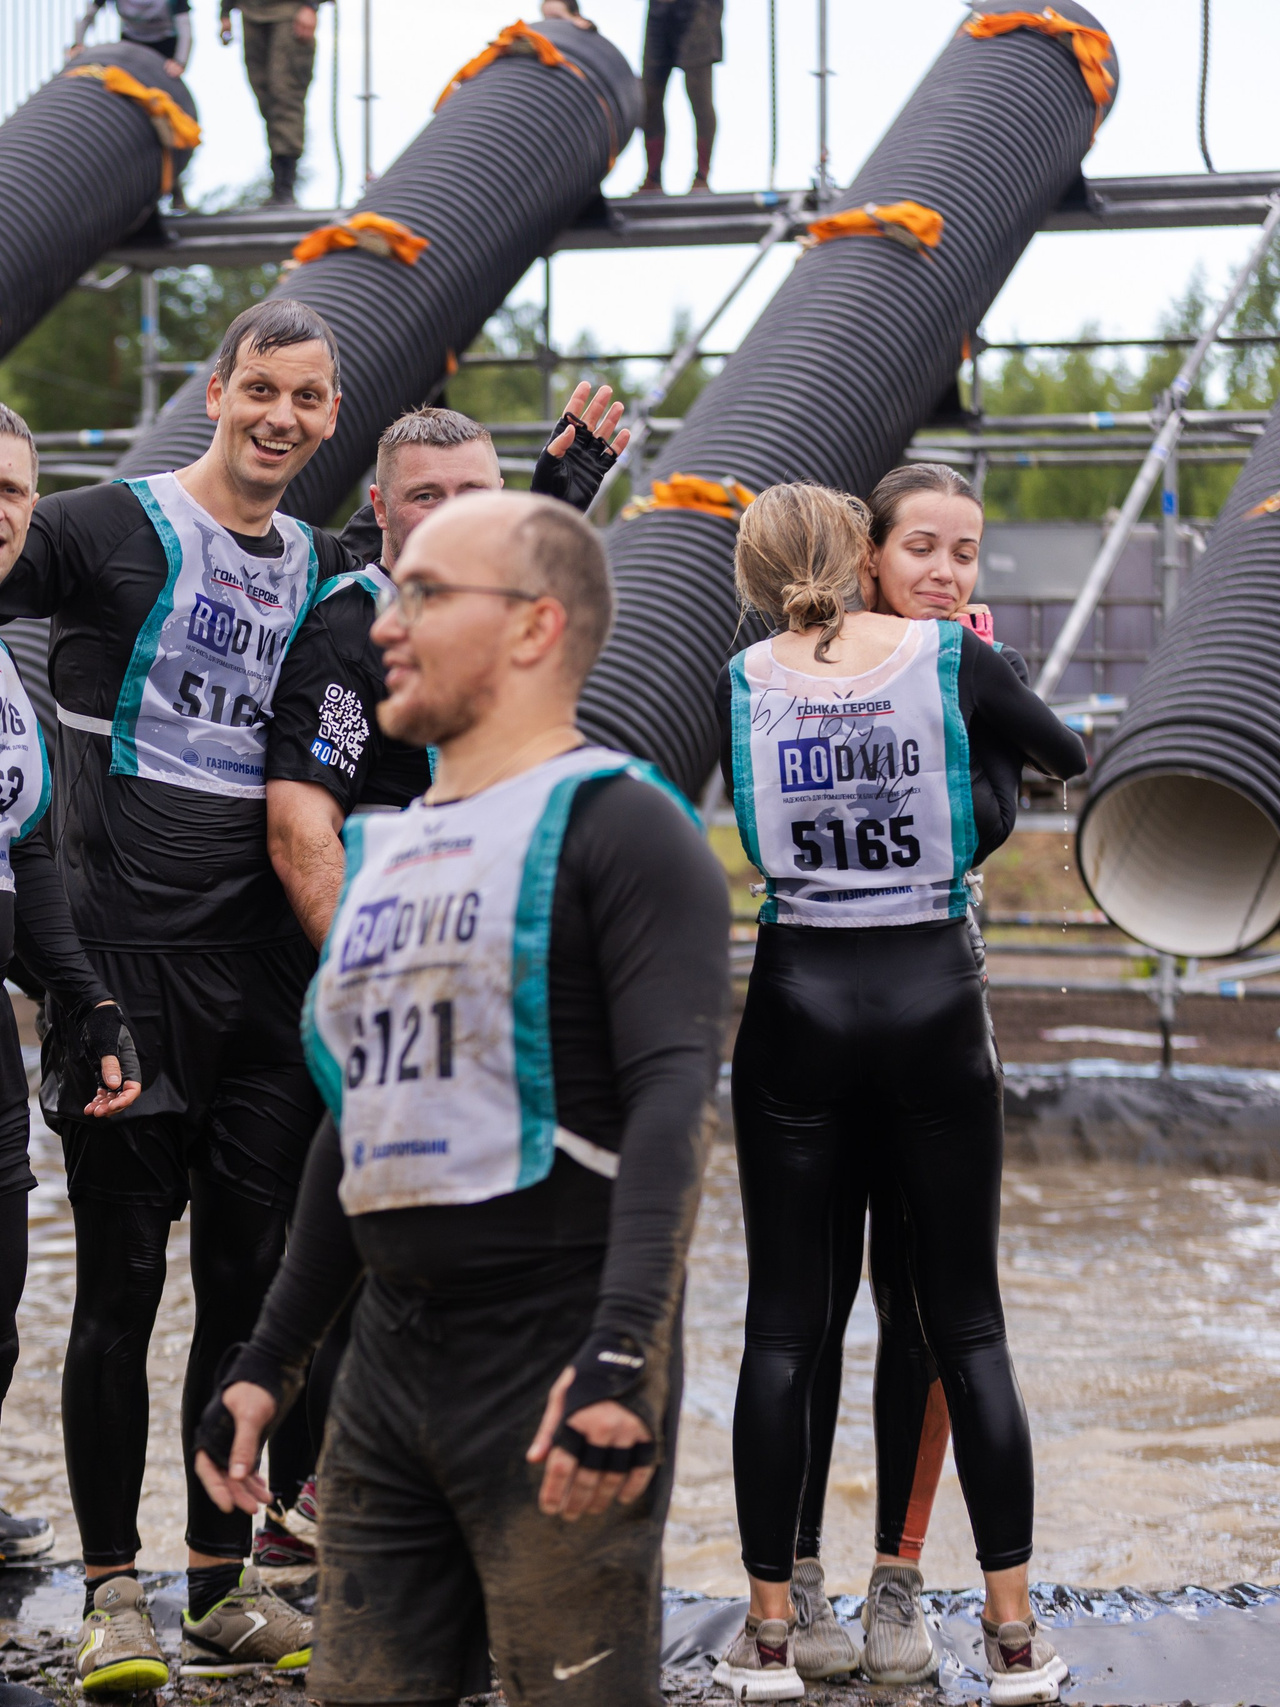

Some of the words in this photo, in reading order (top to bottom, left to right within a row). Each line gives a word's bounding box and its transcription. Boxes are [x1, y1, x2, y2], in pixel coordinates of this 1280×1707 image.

[247, 584, 280, 605] ГЕРОЕВ
[172, 671, 262, 728] 516
[796, 702, 840, 717] ГОНКА
[842, 699, 892, 715] ГЕРОЕВ
[206, 756, 265, 777] ГАЗПРОМБАНК
[781, 738, 920, 787] RODVIG
[790, 814, 922, 872] 5165
[837, 884, 914, 903] ГАЗПРОМБАНК
[343, 890, 480, 967] RODVIG
[345, 1000, 454, 1091] 6121
